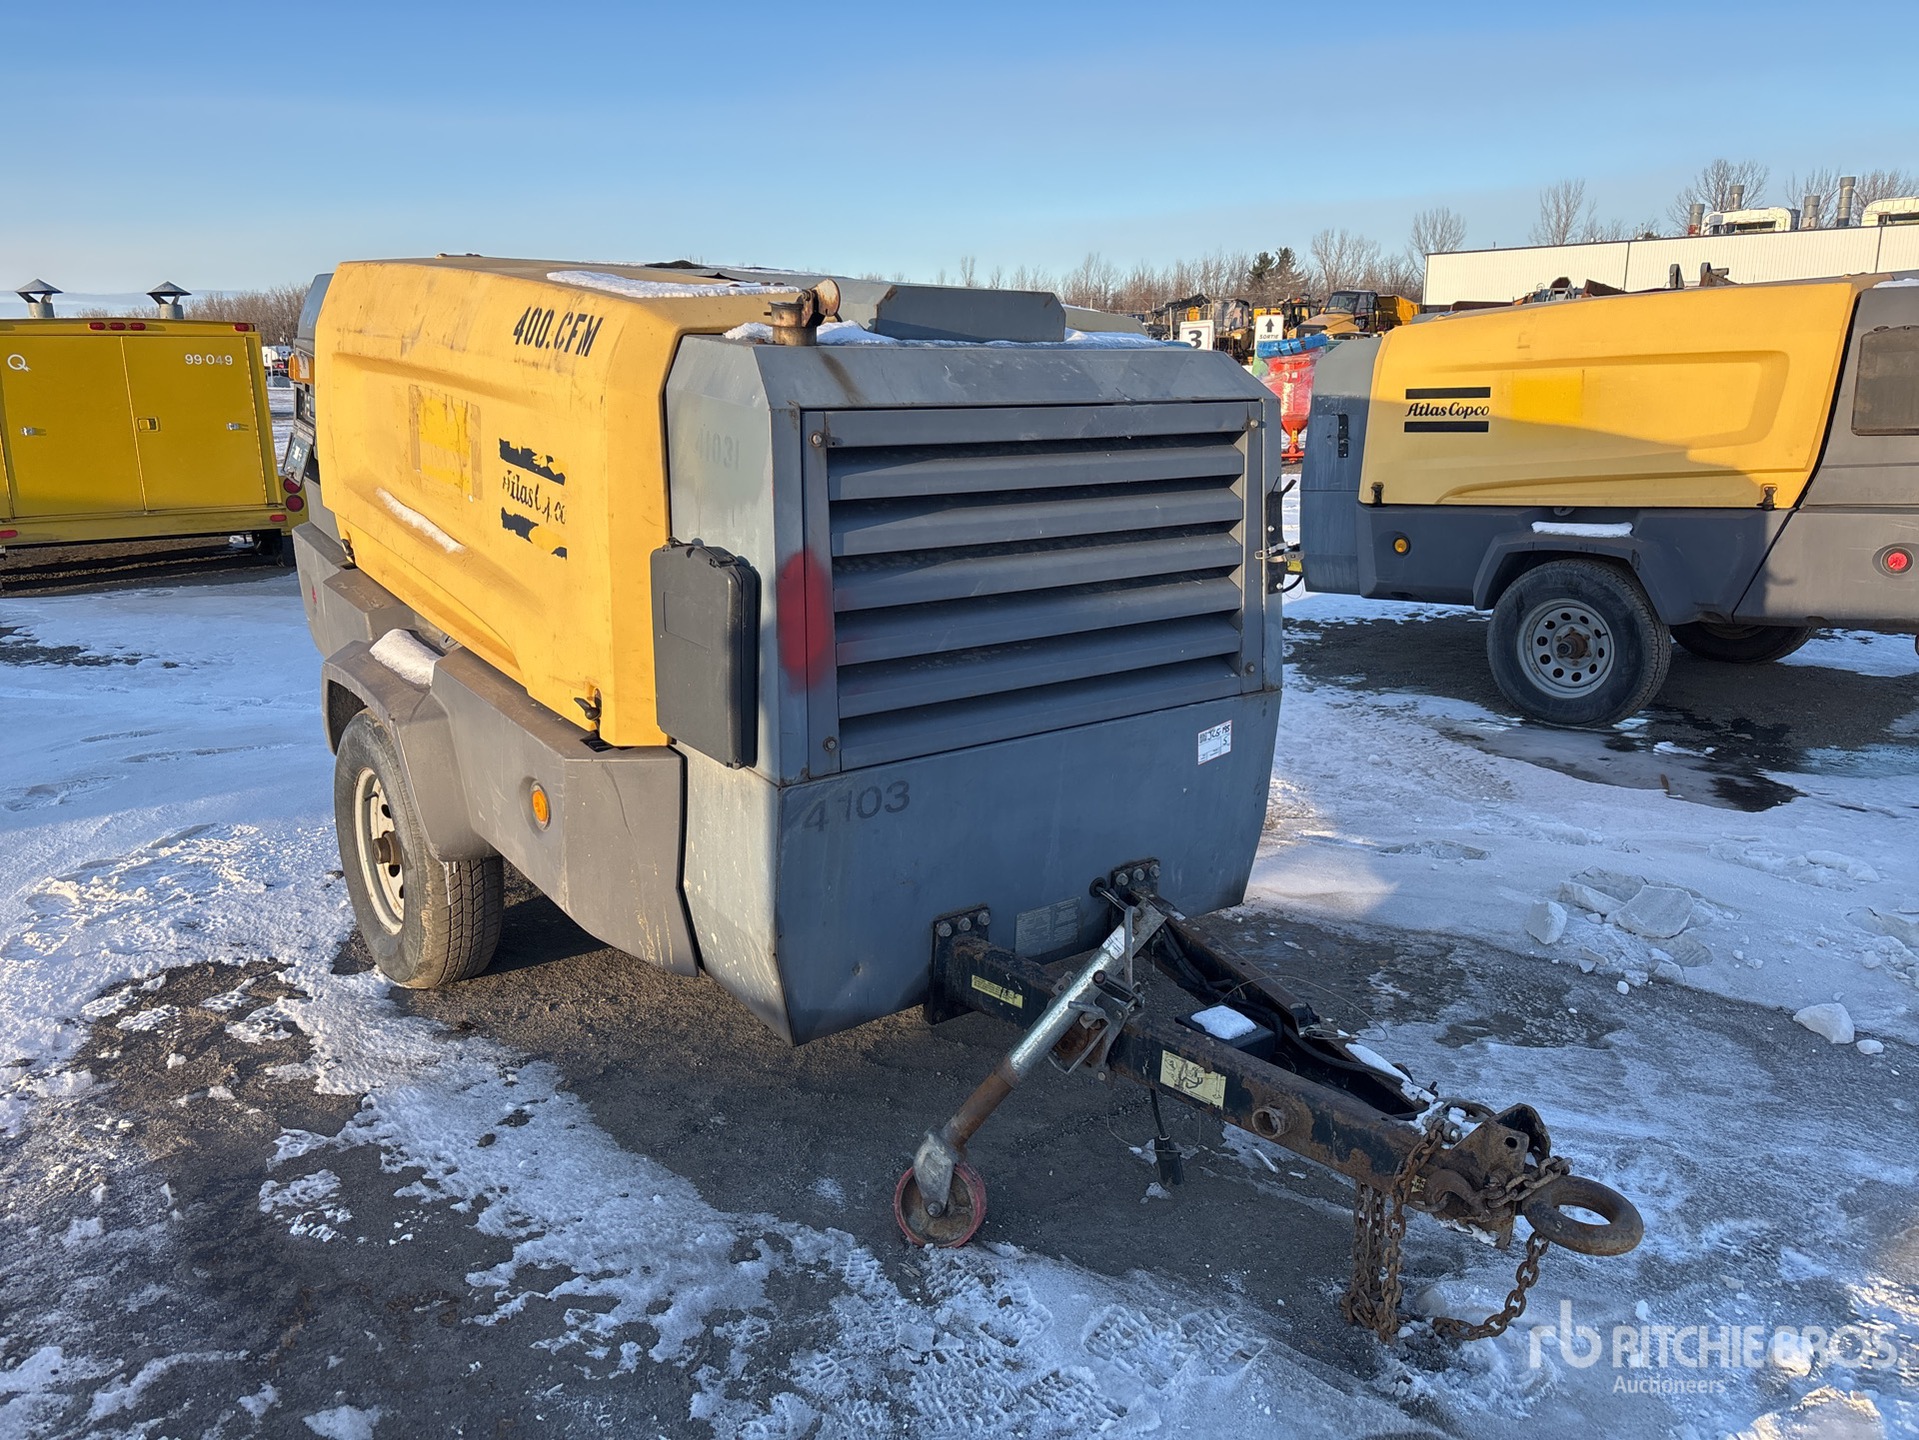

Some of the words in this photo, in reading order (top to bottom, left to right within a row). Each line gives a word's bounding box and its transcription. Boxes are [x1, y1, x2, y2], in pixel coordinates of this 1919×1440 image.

[1188, 329, 1203, 350] 3
[1258, 333, 1280, 341] SORTIE
[1404, 402, 1448, 418] Atlas
[1448, 401, 1490, 420] Copco
[801, 780, 911, 834] 4103
